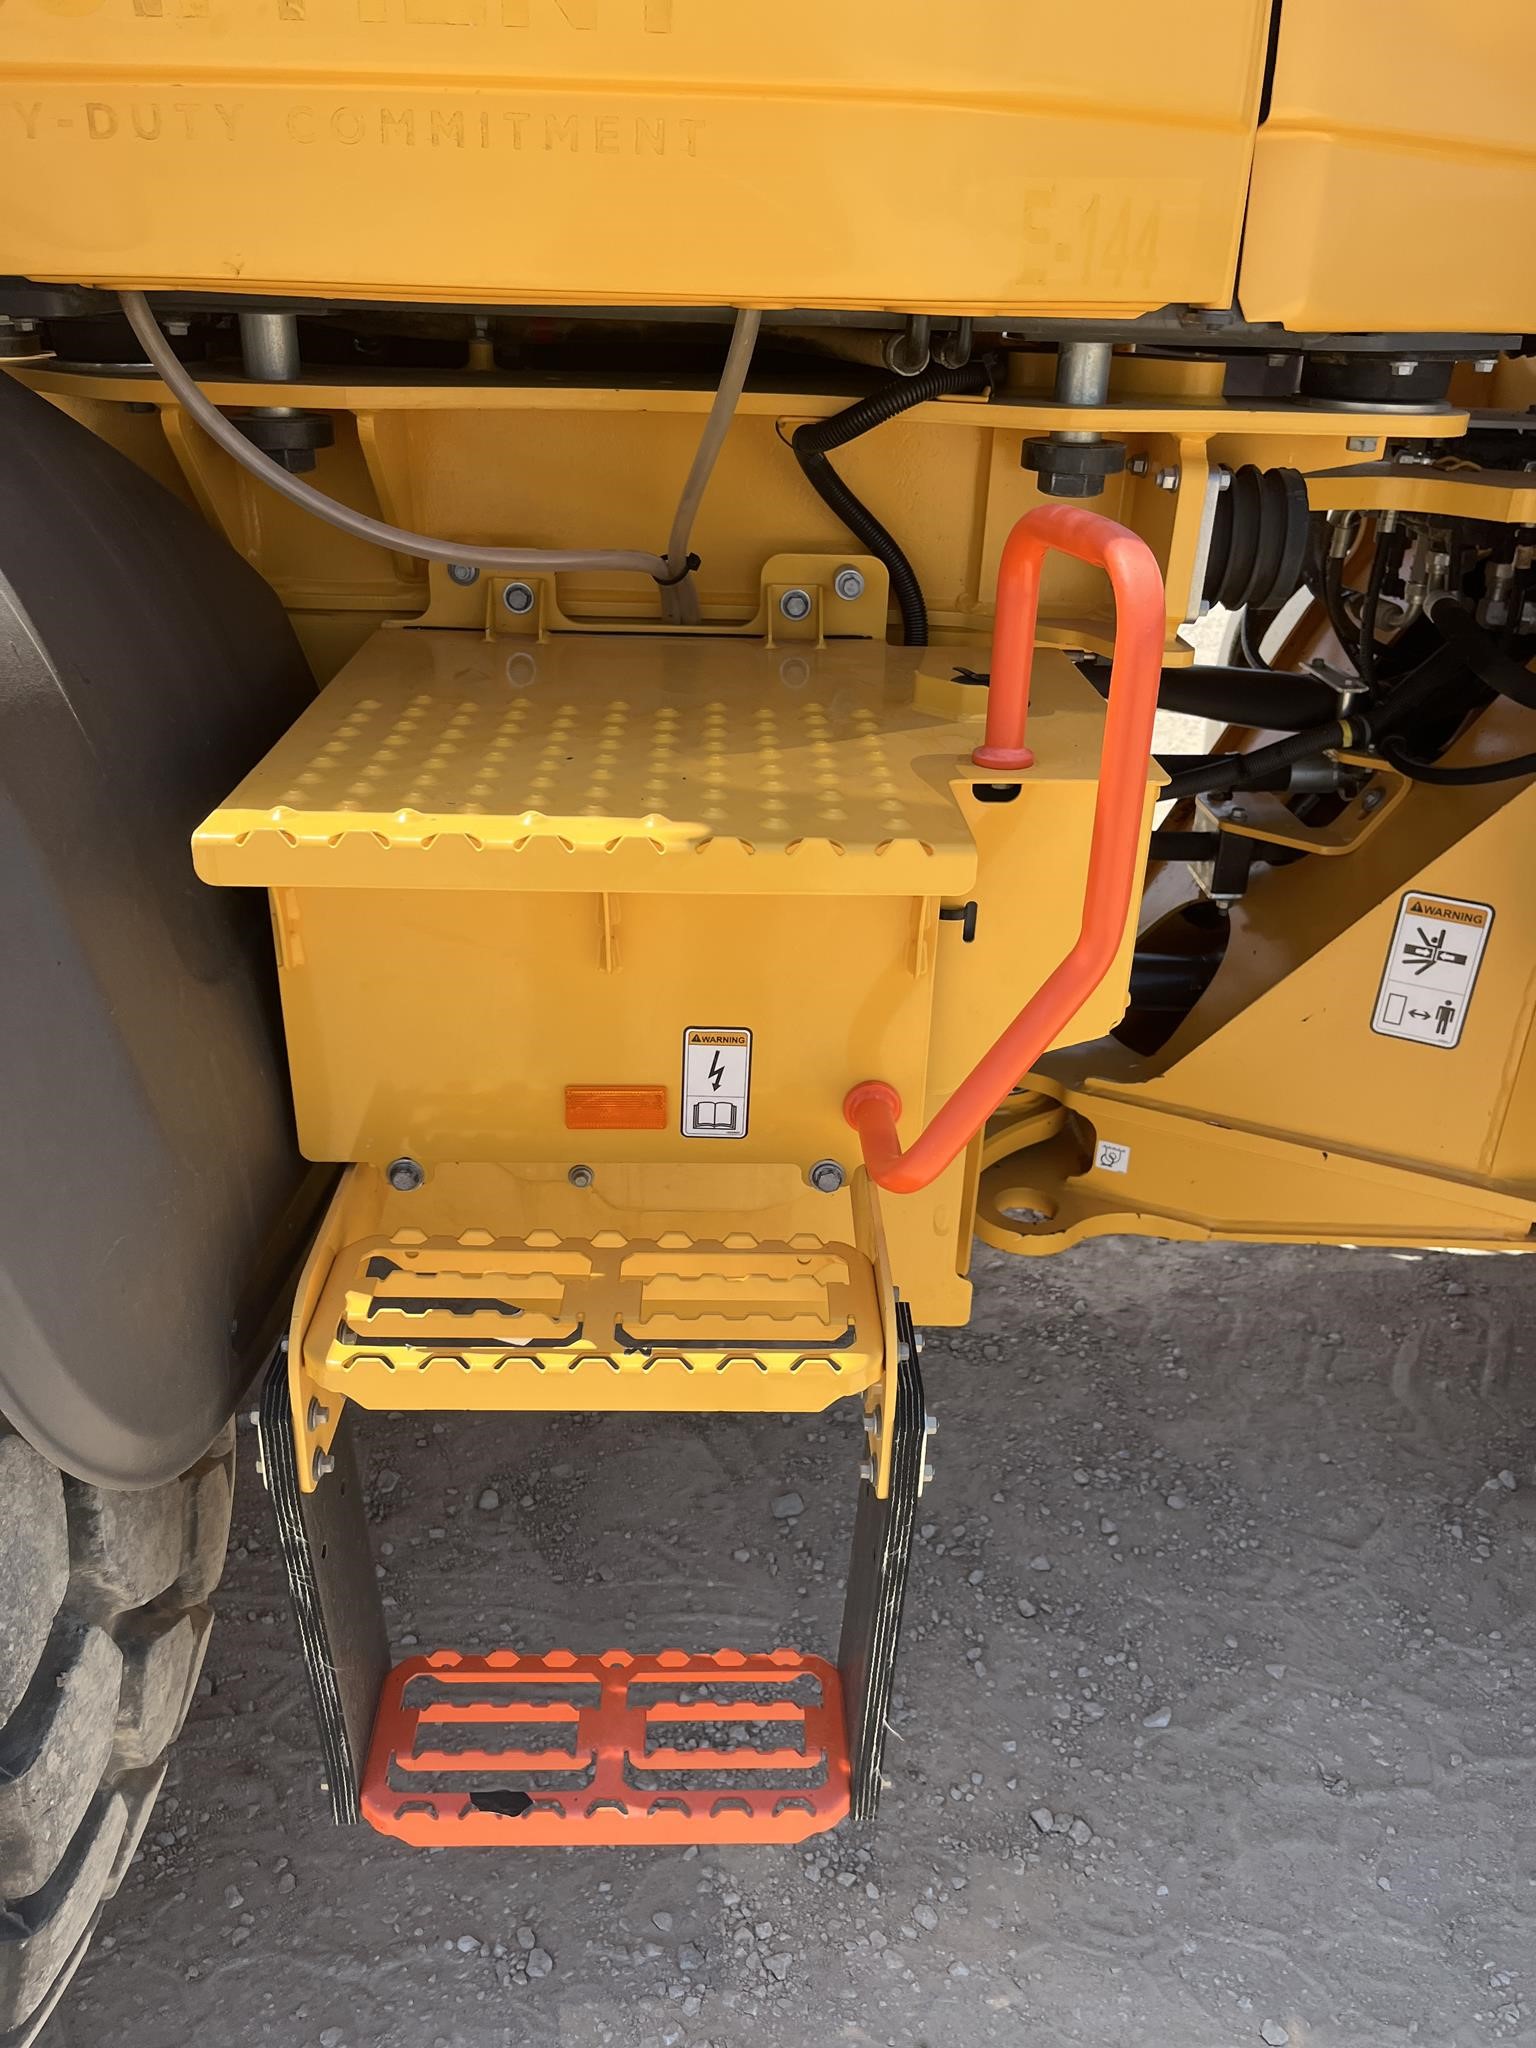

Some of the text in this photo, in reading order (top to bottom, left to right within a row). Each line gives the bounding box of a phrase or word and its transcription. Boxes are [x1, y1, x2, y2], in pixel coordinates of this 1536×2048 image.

[285, 105, 706, 157] COMMITMENT
[1424, 905, 1482, 924] WARNING
[702, 1036, 745, 1044] WARNING
